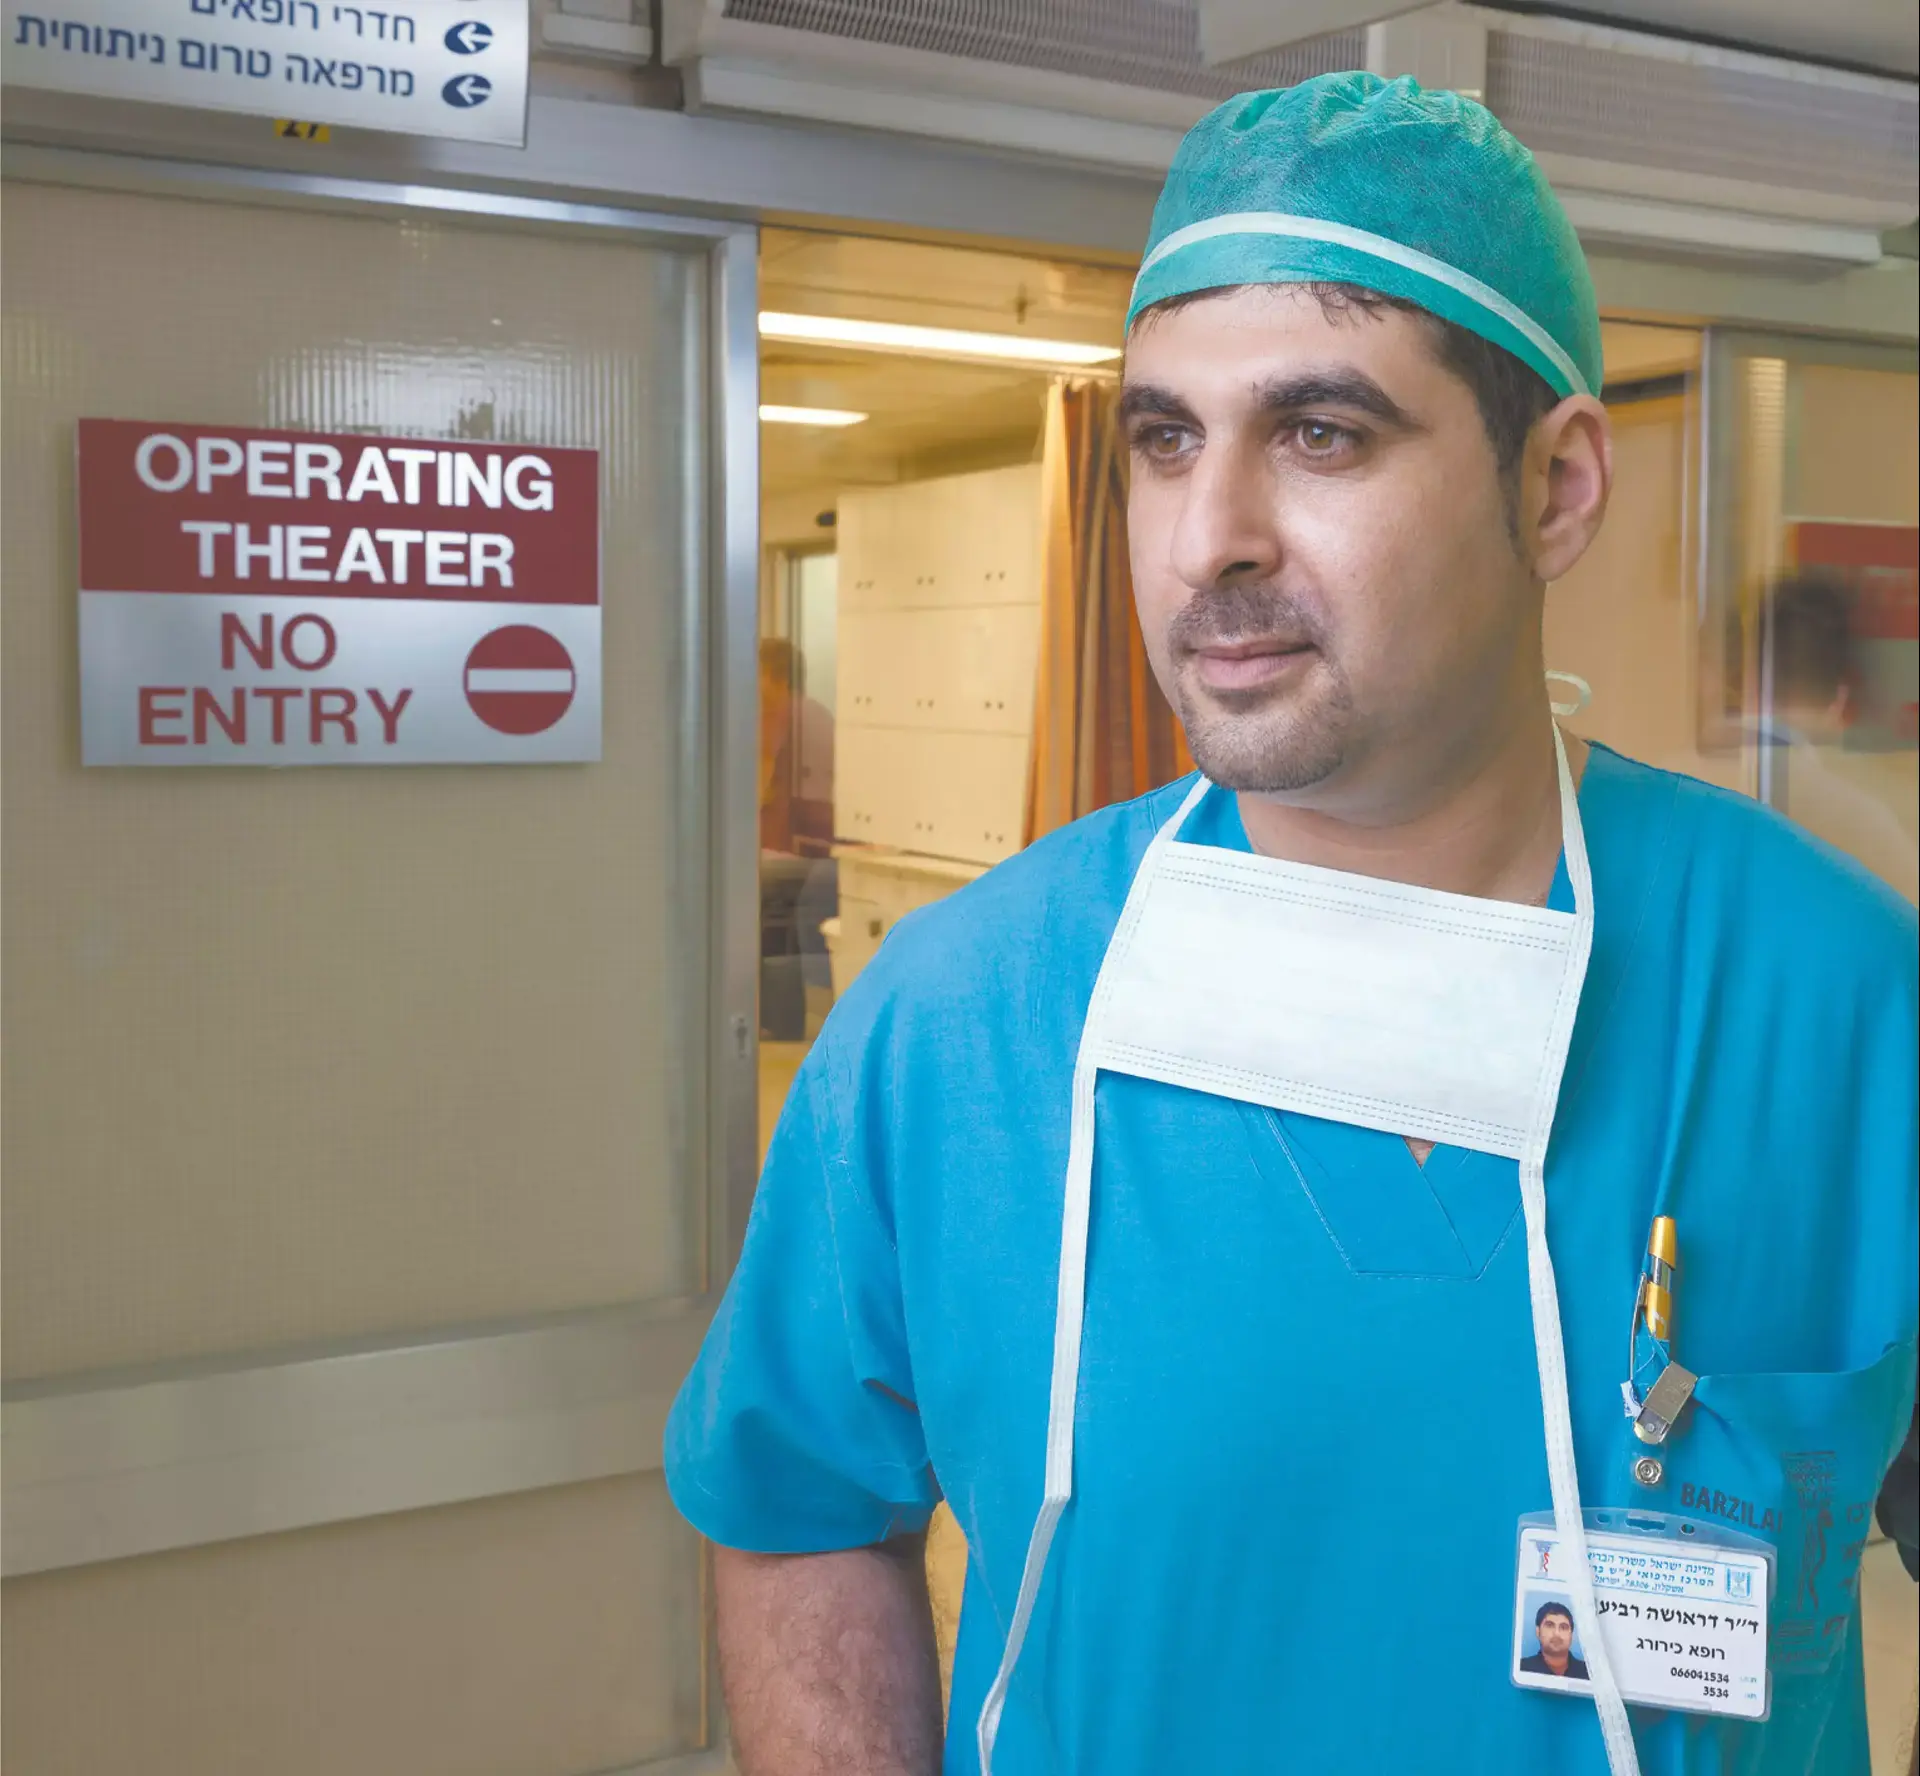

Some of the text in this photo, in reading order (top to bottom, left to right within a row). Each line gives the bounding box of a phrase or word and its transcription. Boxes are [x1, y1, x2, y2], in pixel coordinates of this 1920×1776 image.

[333, 6, 415, 43] חדרי
[14, 14, 414, 97] מרפאה טרום ניתוחית
[135, 433, 555, 511] OPERATING
[180, 521, 515, 588] THEATER
[220, 612, 337, 671] NO
[138, 686, 413, 746] ENTRY
[1681, 1482, 1783, 1533] BARZILAI
[1619, 1555, 1647, 1567] משרד
[1650, 1558, 1682, 1571] ישראל
[1685, 1563, 1715, 1576] מדינת
[1646, 1606, 1718, 1628] דראושה
[1636, 1637, 1726, 1661] רופא כירורג
[1703, 1685, 1729, 1699] 3534
